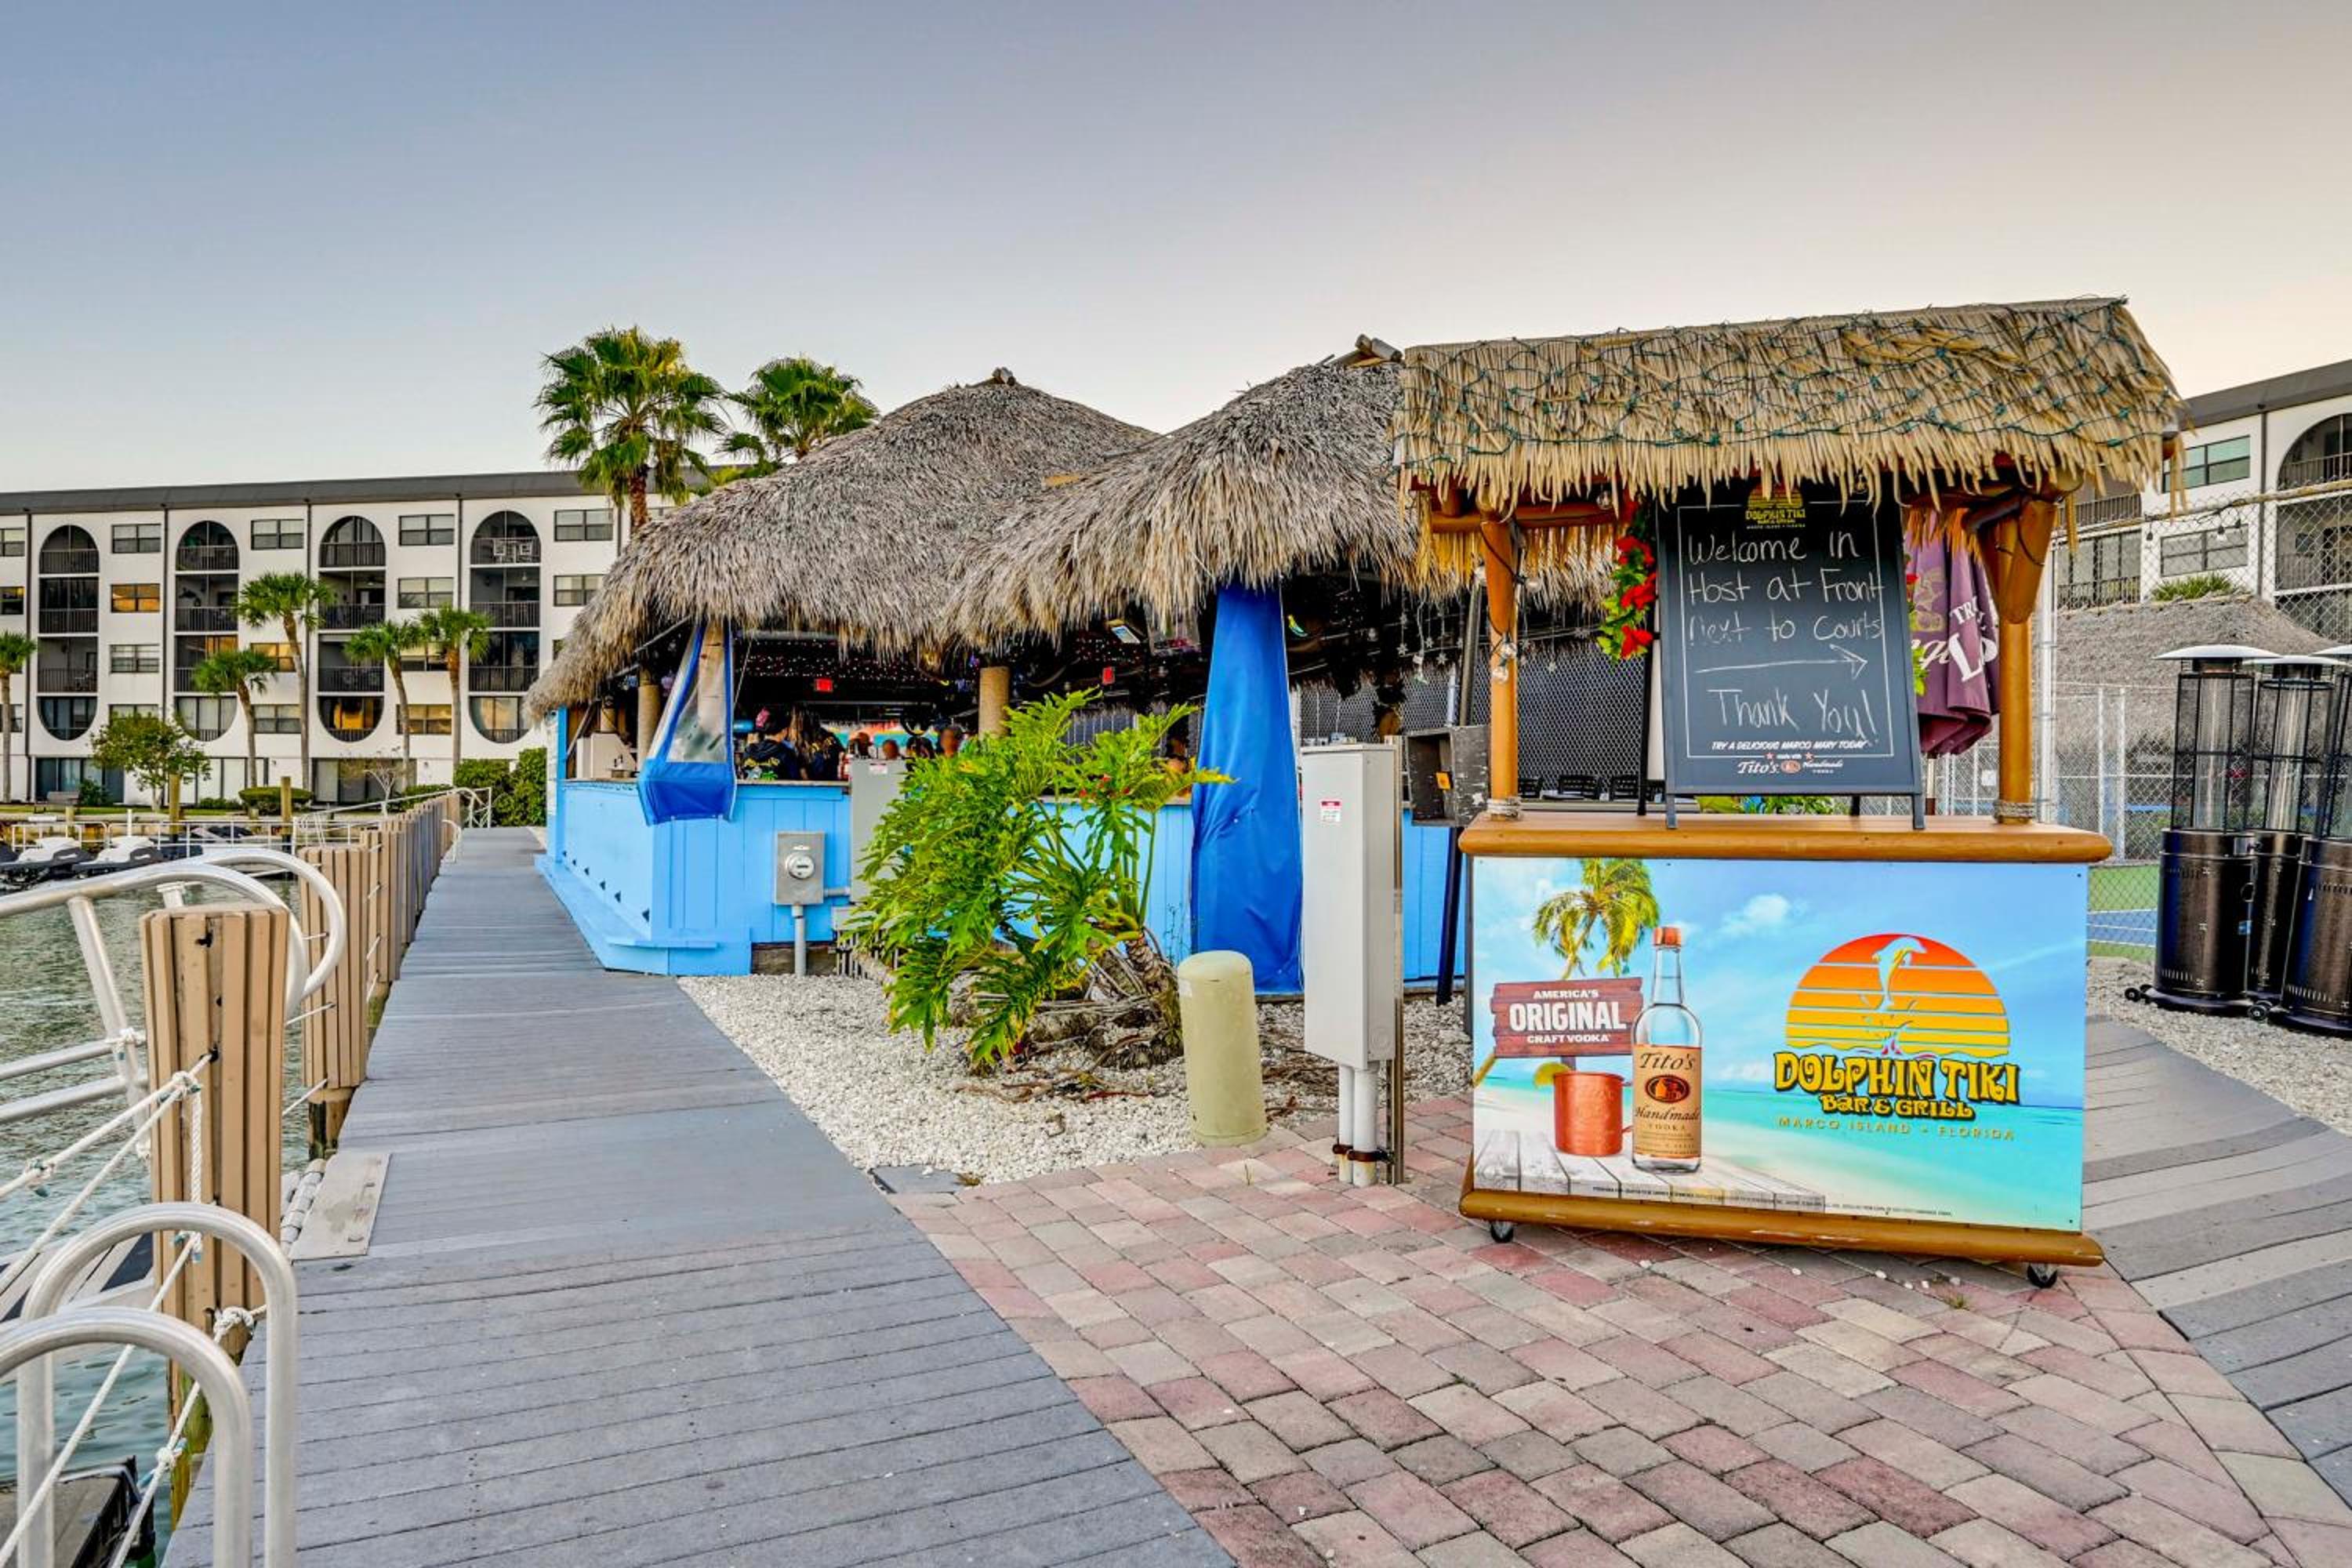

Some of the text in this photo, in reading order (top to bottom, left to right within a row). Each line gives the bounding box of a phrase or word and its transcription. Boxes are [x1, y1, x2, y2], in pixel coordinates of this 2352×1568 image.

[1688, 531, 1807, 564] Welcome
[1688, 567, 1886, 605] Host at Front
[1765, 607, 1796, 641] to
[1813, 611, 1882, 641] Courts
[1707, 688, 1879, 743] Thank You!
[1711, 741, 1729, 750] TRY
[1737, 741, 1780, 750] DELICIOUS
[1781, 740, 1812, 750] MARCO
[1813, 740, 1838, 750] MARY
[1737, 760, 1779, 775] Tito's
[1533, 989, 1599, 1000] AMERICA'S
[1509, 1001, 1627, 1032] ORIGINAL
[1526, 1033, 1610, 1044] CRAFT VODKA
[1639, 1051, 1696, 1071] Tito's
[1773, 1051, 2020, 1105] DOLPHIN TIKI
[1894, 1098, 1976, 1120] GRILL
[1778, 1116, 2015, 1141] MARCO ISLAND FLORIDA
